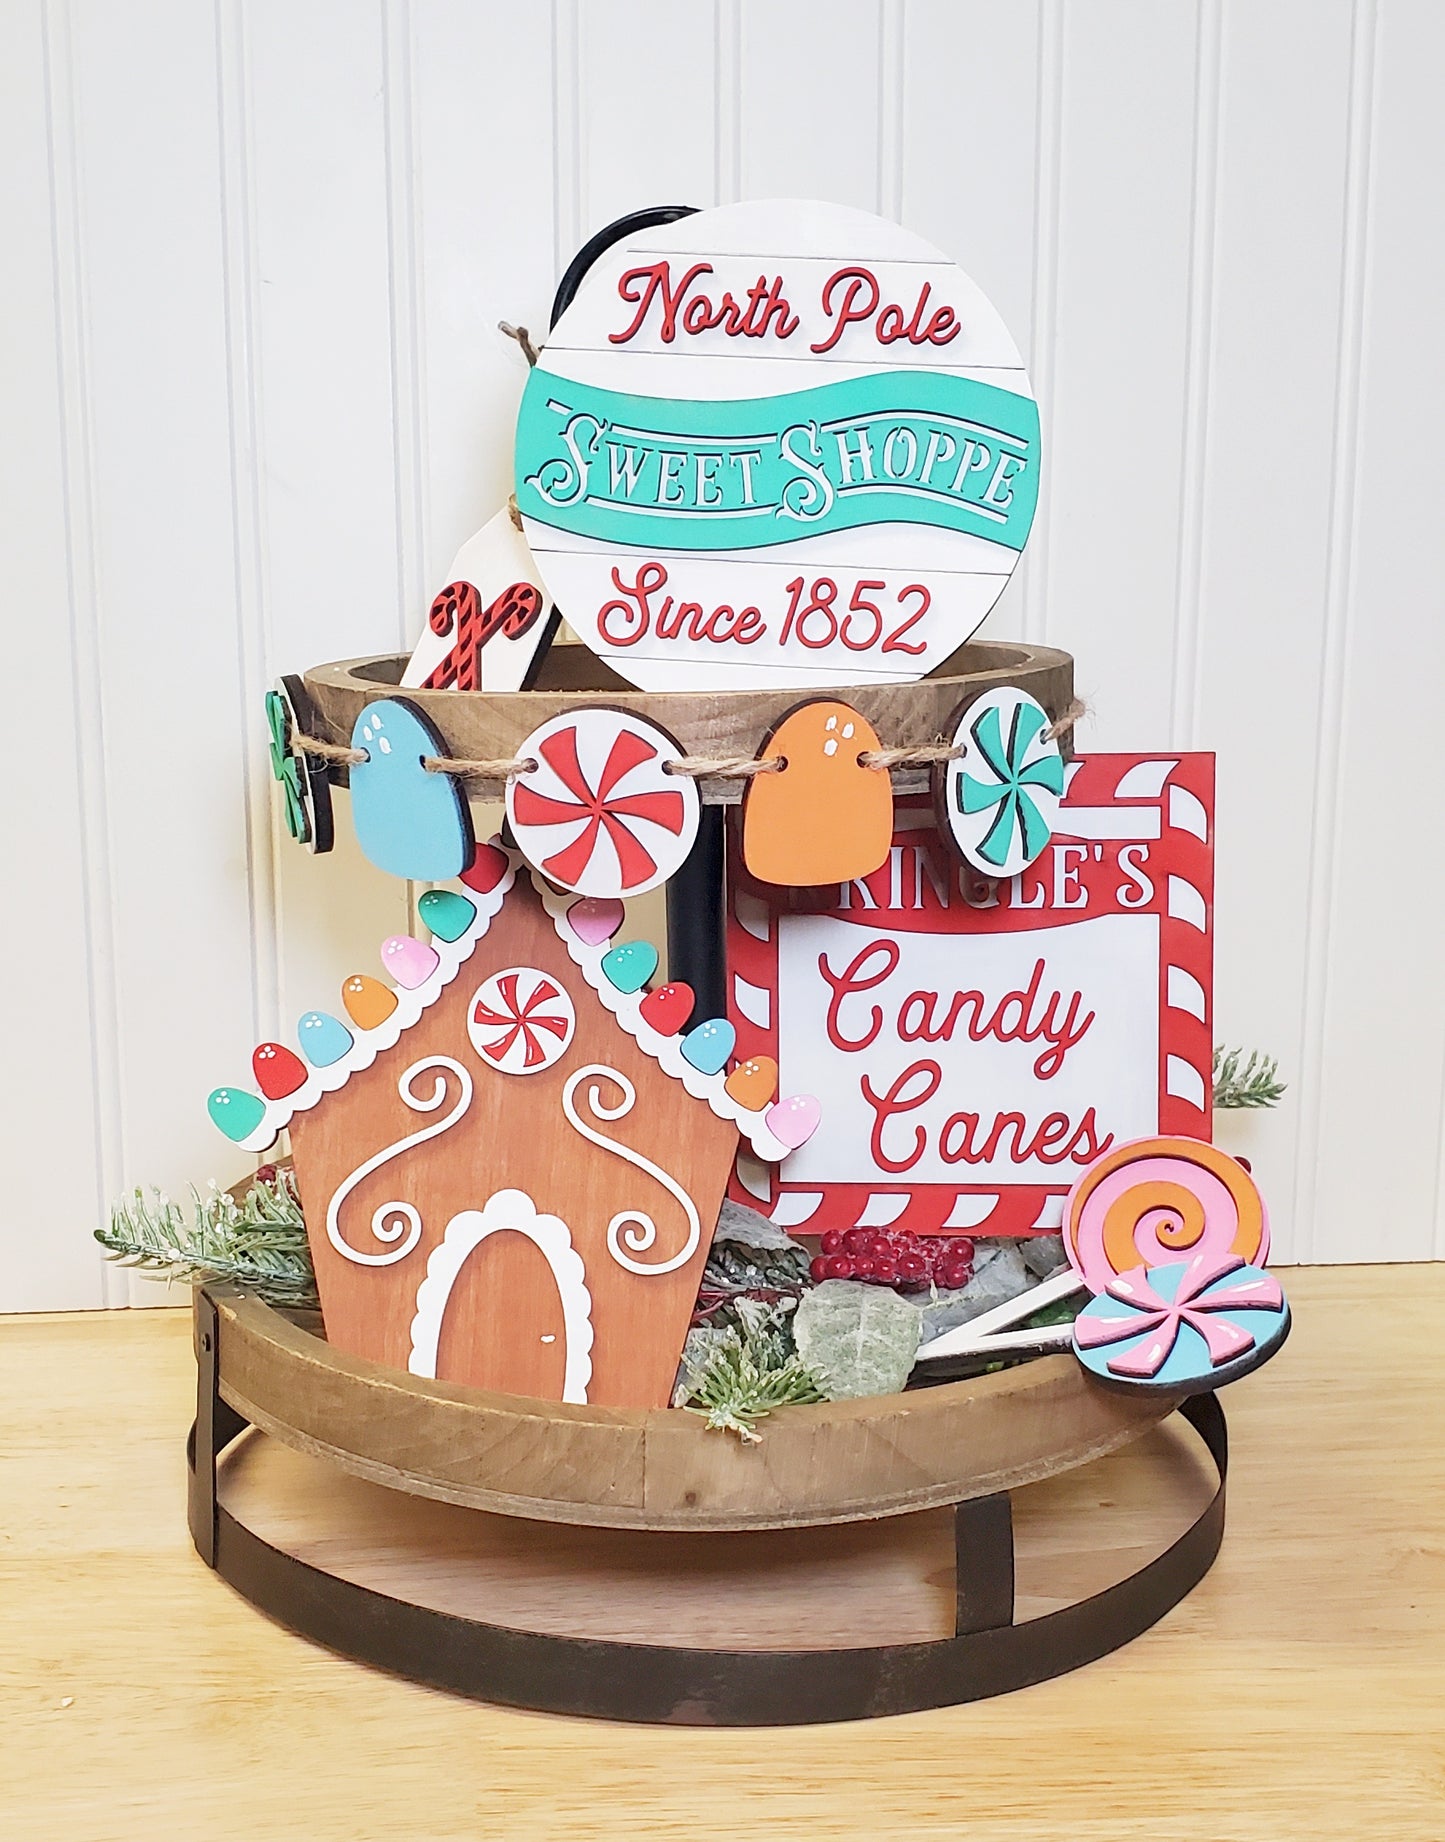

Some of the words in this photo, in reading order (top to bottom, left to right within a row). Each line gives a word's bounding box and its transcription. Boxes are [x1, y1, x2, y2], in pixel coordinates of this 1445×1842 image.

[608, 261, 800, 344] North
[809, 266, 961, 354] Pole
[523, 411, 763, 508] SWEET
[774, 419, 1028, 522] SHOPPE
[596, 562, 767, 648] Since
[778, 576, 932, 655] 1852
[789, 844, 1155, 909] INGLE'S
[817, 938, 1096, 1080] Candy
[860, 1059, 1114, 1174] Canes
